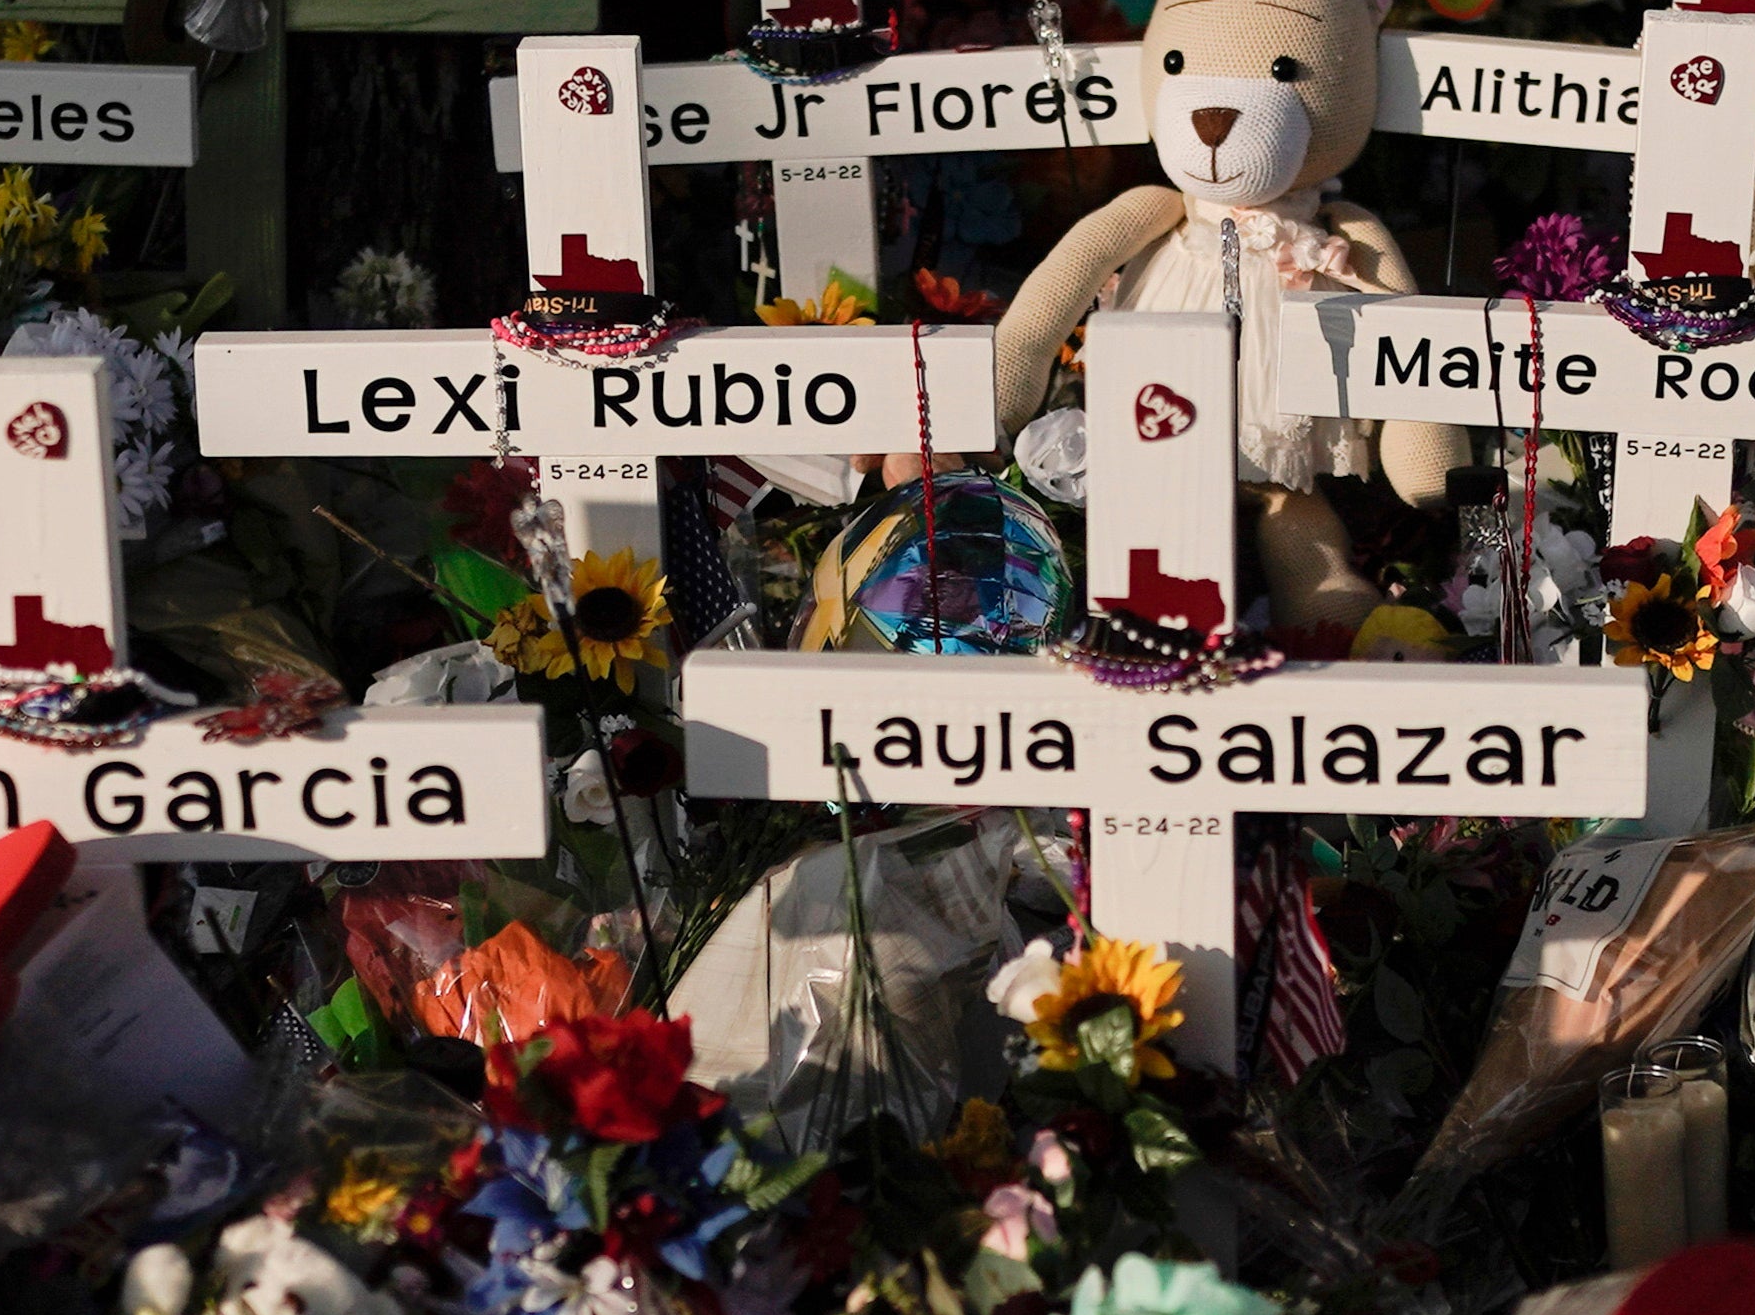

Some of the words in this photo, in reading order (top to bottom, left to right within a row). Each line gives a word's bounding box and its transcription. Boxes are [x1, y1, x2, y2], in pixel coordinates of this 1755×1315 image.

[646, 102, 711, 148] se
[755, 82, 825, 140] Jr
[868, 74, 1118, 136] Flores
[1420, 65, 1640, 126] Alithia
[780, 164, 862, 183] 5-24-22
[525, 296, 597, 316] Tri-Sta
[1374, 336, 1597, 396] Maite
[304, 365, 521, 435] Lexi
[592, 363, 857, 428] Rubio
[550, 463, 648, 481] 5-24-22
[1627, 440, 1726, 460] 5-24-22
[820, 708, 1076, 785] Layla
[1147, 714, 1586, 787] Salazar
[84, 756, 466, 833] Garcia
[1104, 817, 1219, 835] 5-24-22
